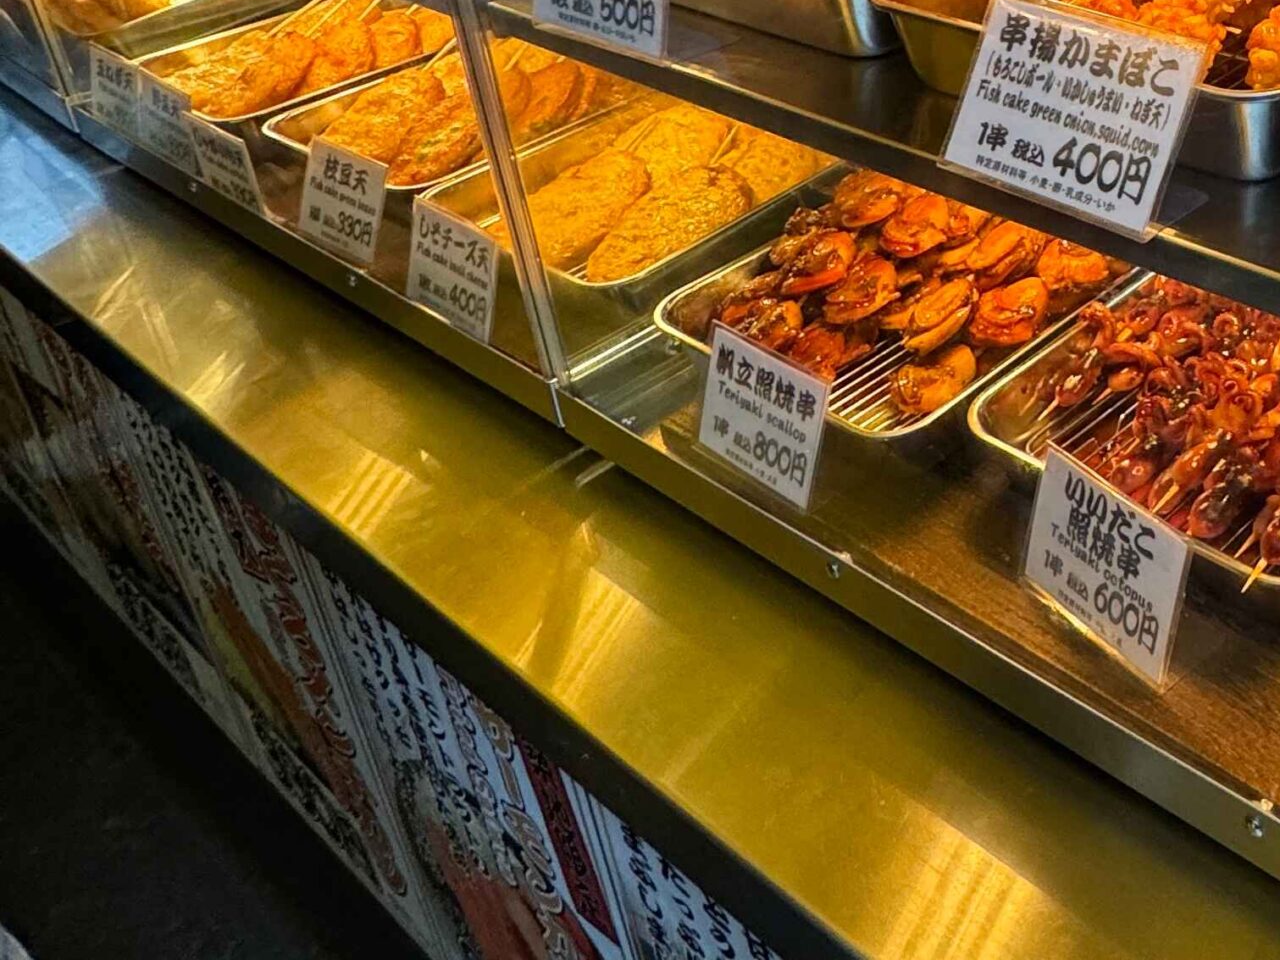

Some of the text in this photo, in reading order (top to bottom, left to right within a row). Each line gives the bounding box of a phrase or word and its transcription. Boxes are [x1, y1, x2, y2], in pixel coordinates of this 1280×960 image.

[999, 12, 1179, 96] 串揚かまぼこ
[976, 79, 1001, 104] Fish
[1003, 91, 1030, 113] cake
[1029, 102, 1061, 125] green
[323, 154, 369, 195] 枝豆天
[977, 121, 1151, 206] 1串 税込 400円
[450, 283, 487, 325] 400円
[716, 343, 816, 422] 帆立照焼串
[718, 380, 807, 443] Teriyaki scallop
[752, 430, 808, 488] 800円
[1065, 470, 1156, 561] いいだこ
[1066, 506, 1141, 580] 照焼串
[1050, 522, 1154, 613] Teriyaki octopus
[1094, 581, 1160, 655] 600円
